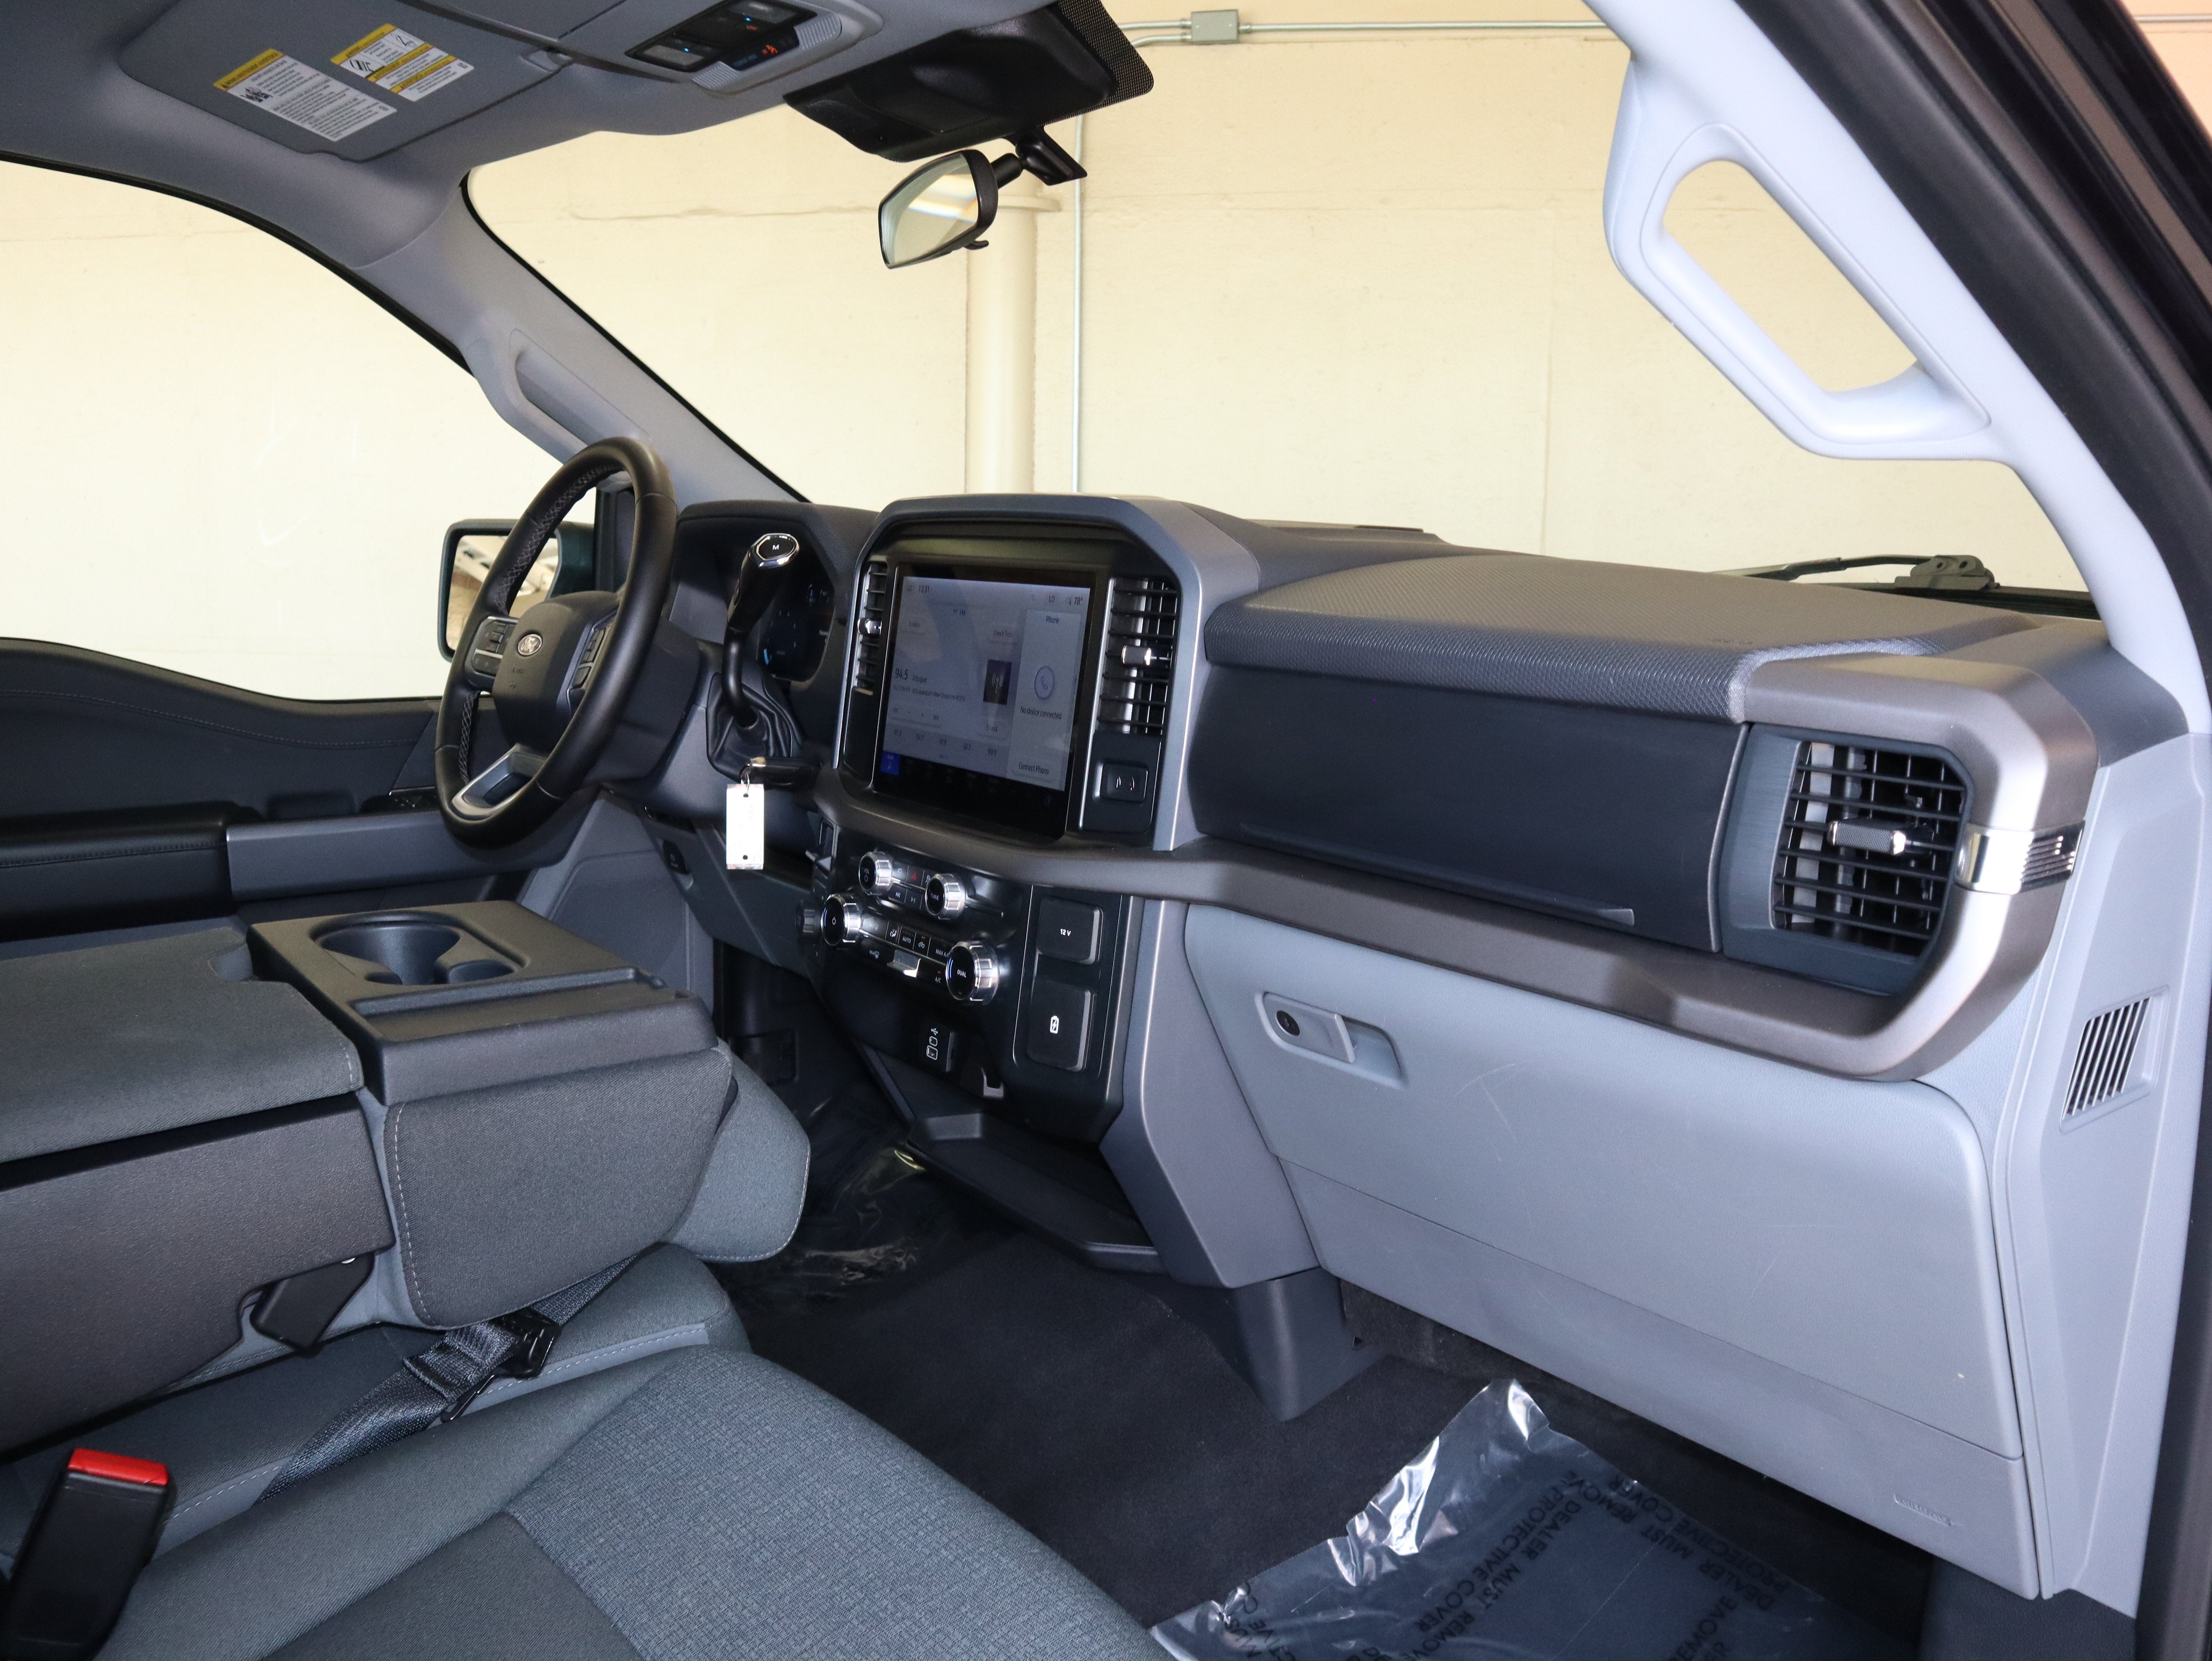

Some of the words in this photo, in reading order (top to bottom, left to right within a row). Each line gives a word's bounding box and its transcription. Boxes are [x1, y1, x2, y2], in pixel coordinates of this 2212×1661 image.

[1045, 616, 1060, 625] Phone
[894, 667, 909, 680] 94.5
[1026, 707, 1040, 716] device
[1040, 709, 1062, 720] connected
[1018, 761, 1035, 772] Connect
[1035, 765, 1050, 776] Phone
[902, 936, 912, 944] AUTO
[935, 948, 944, 956] MAX
[957, 969, 967, 978] DUAL
[1472, 1486, 1564, 1582] PROTECTIVE
[1521, 1500, 1582, 1560] DEALER
[1640, 1524, 1694, 1560] MUST
[1477, 1563, 1522, 1610] MUST
[1698, 1558, 1776, 1611] DEALER
[1414, 1579, 1475, 1632] COVER
